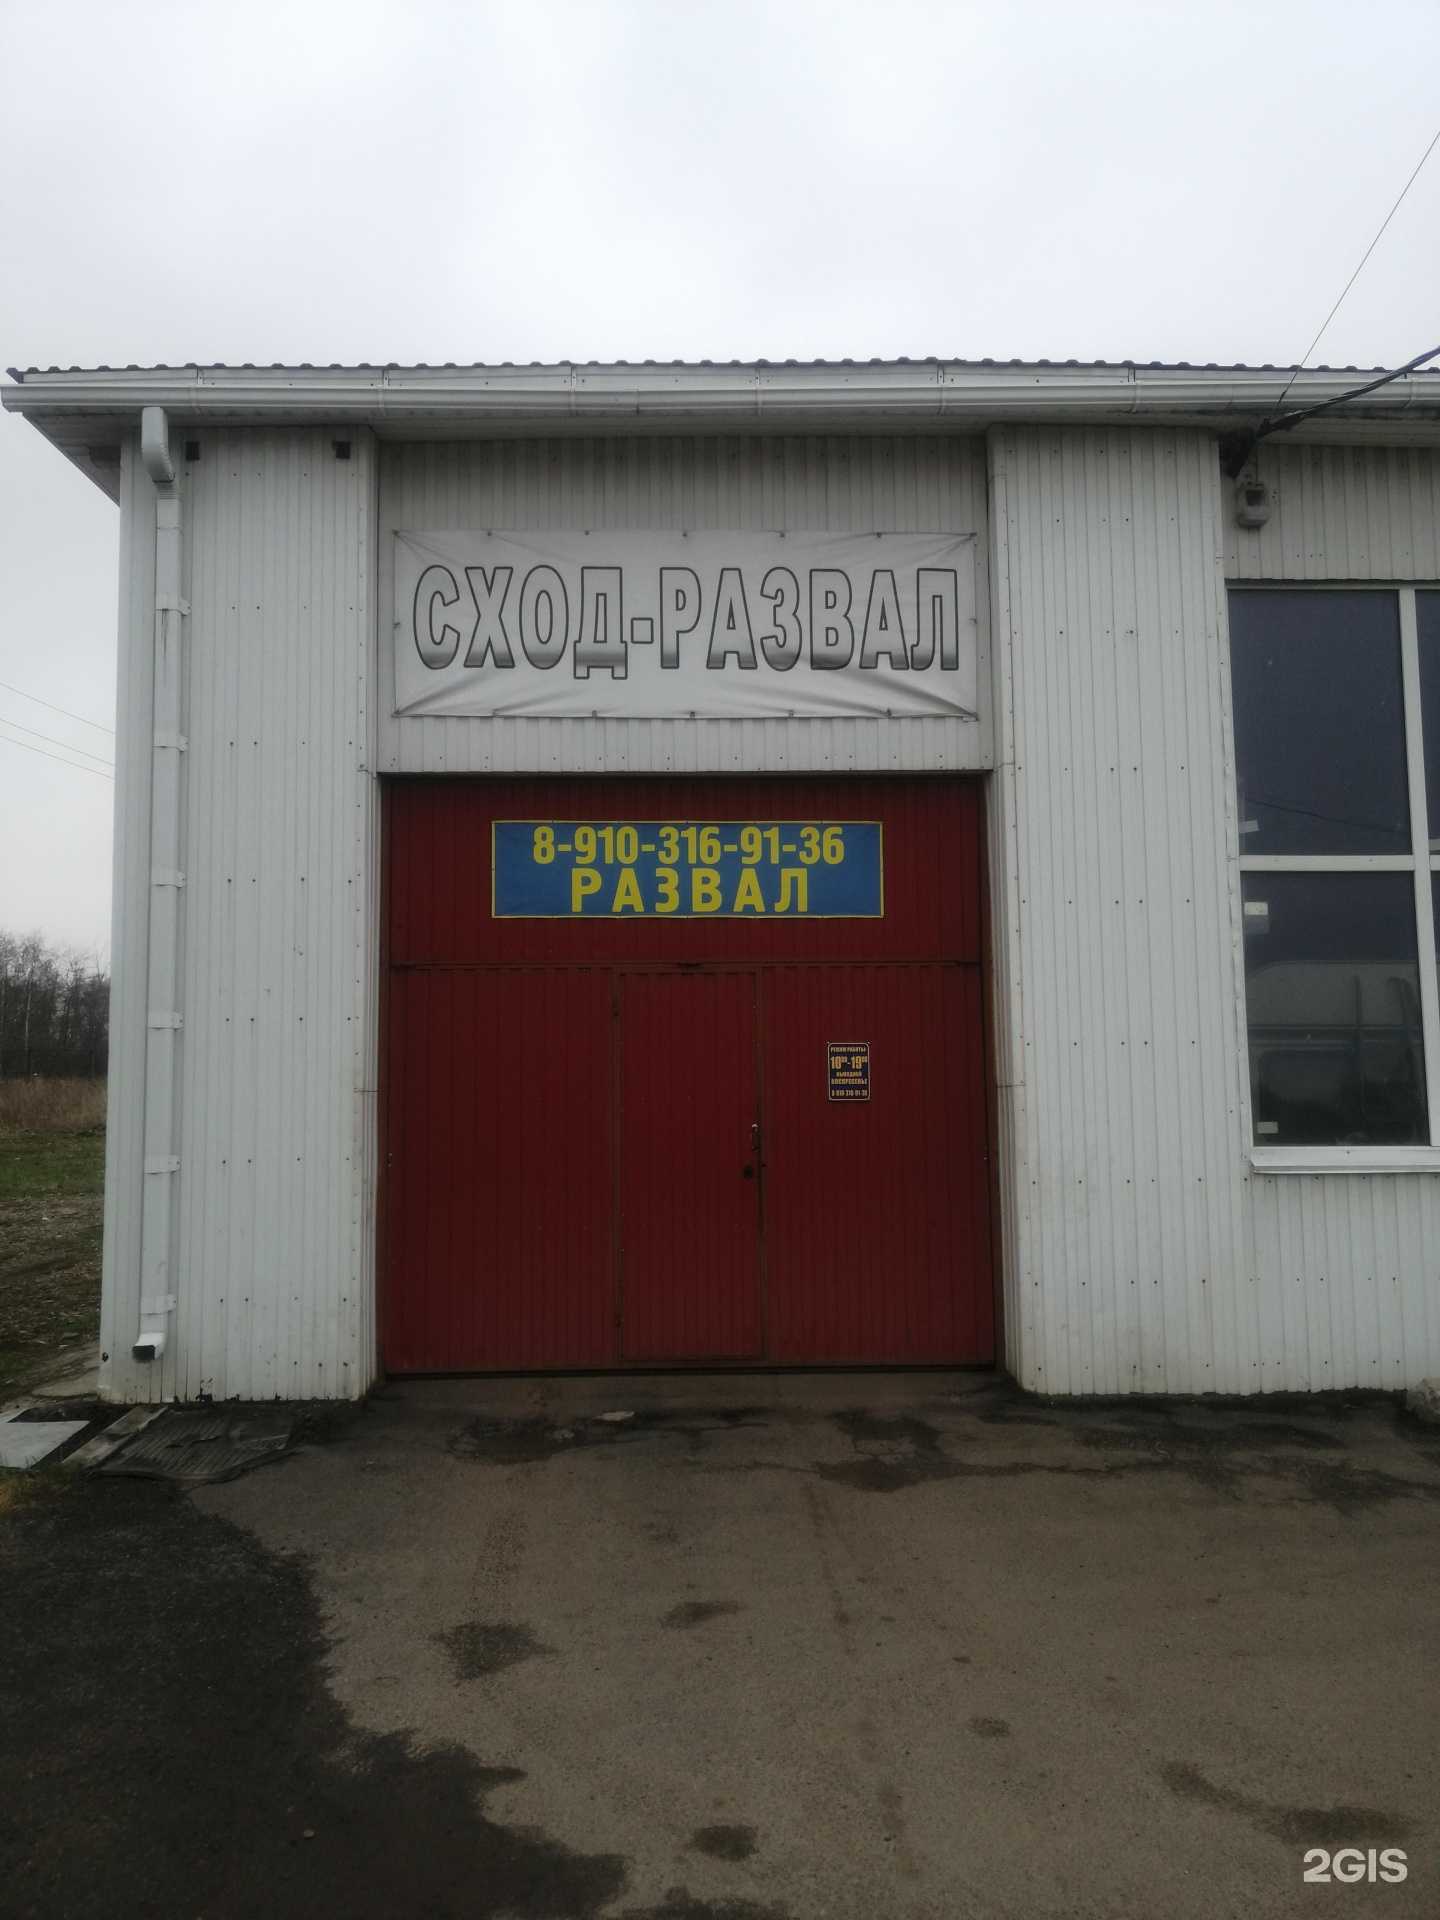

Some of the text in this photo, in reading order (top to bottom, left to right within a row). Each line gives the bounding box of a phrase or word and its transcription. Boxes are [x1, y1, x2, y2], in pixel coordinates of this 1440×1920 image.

[413, 565, 959, 679] СХОД-РАЗВАЛ
[533, 827, 844, 865] 8-910-316-91-36
[571, 868, 808, 913] РАЗВАЛ
